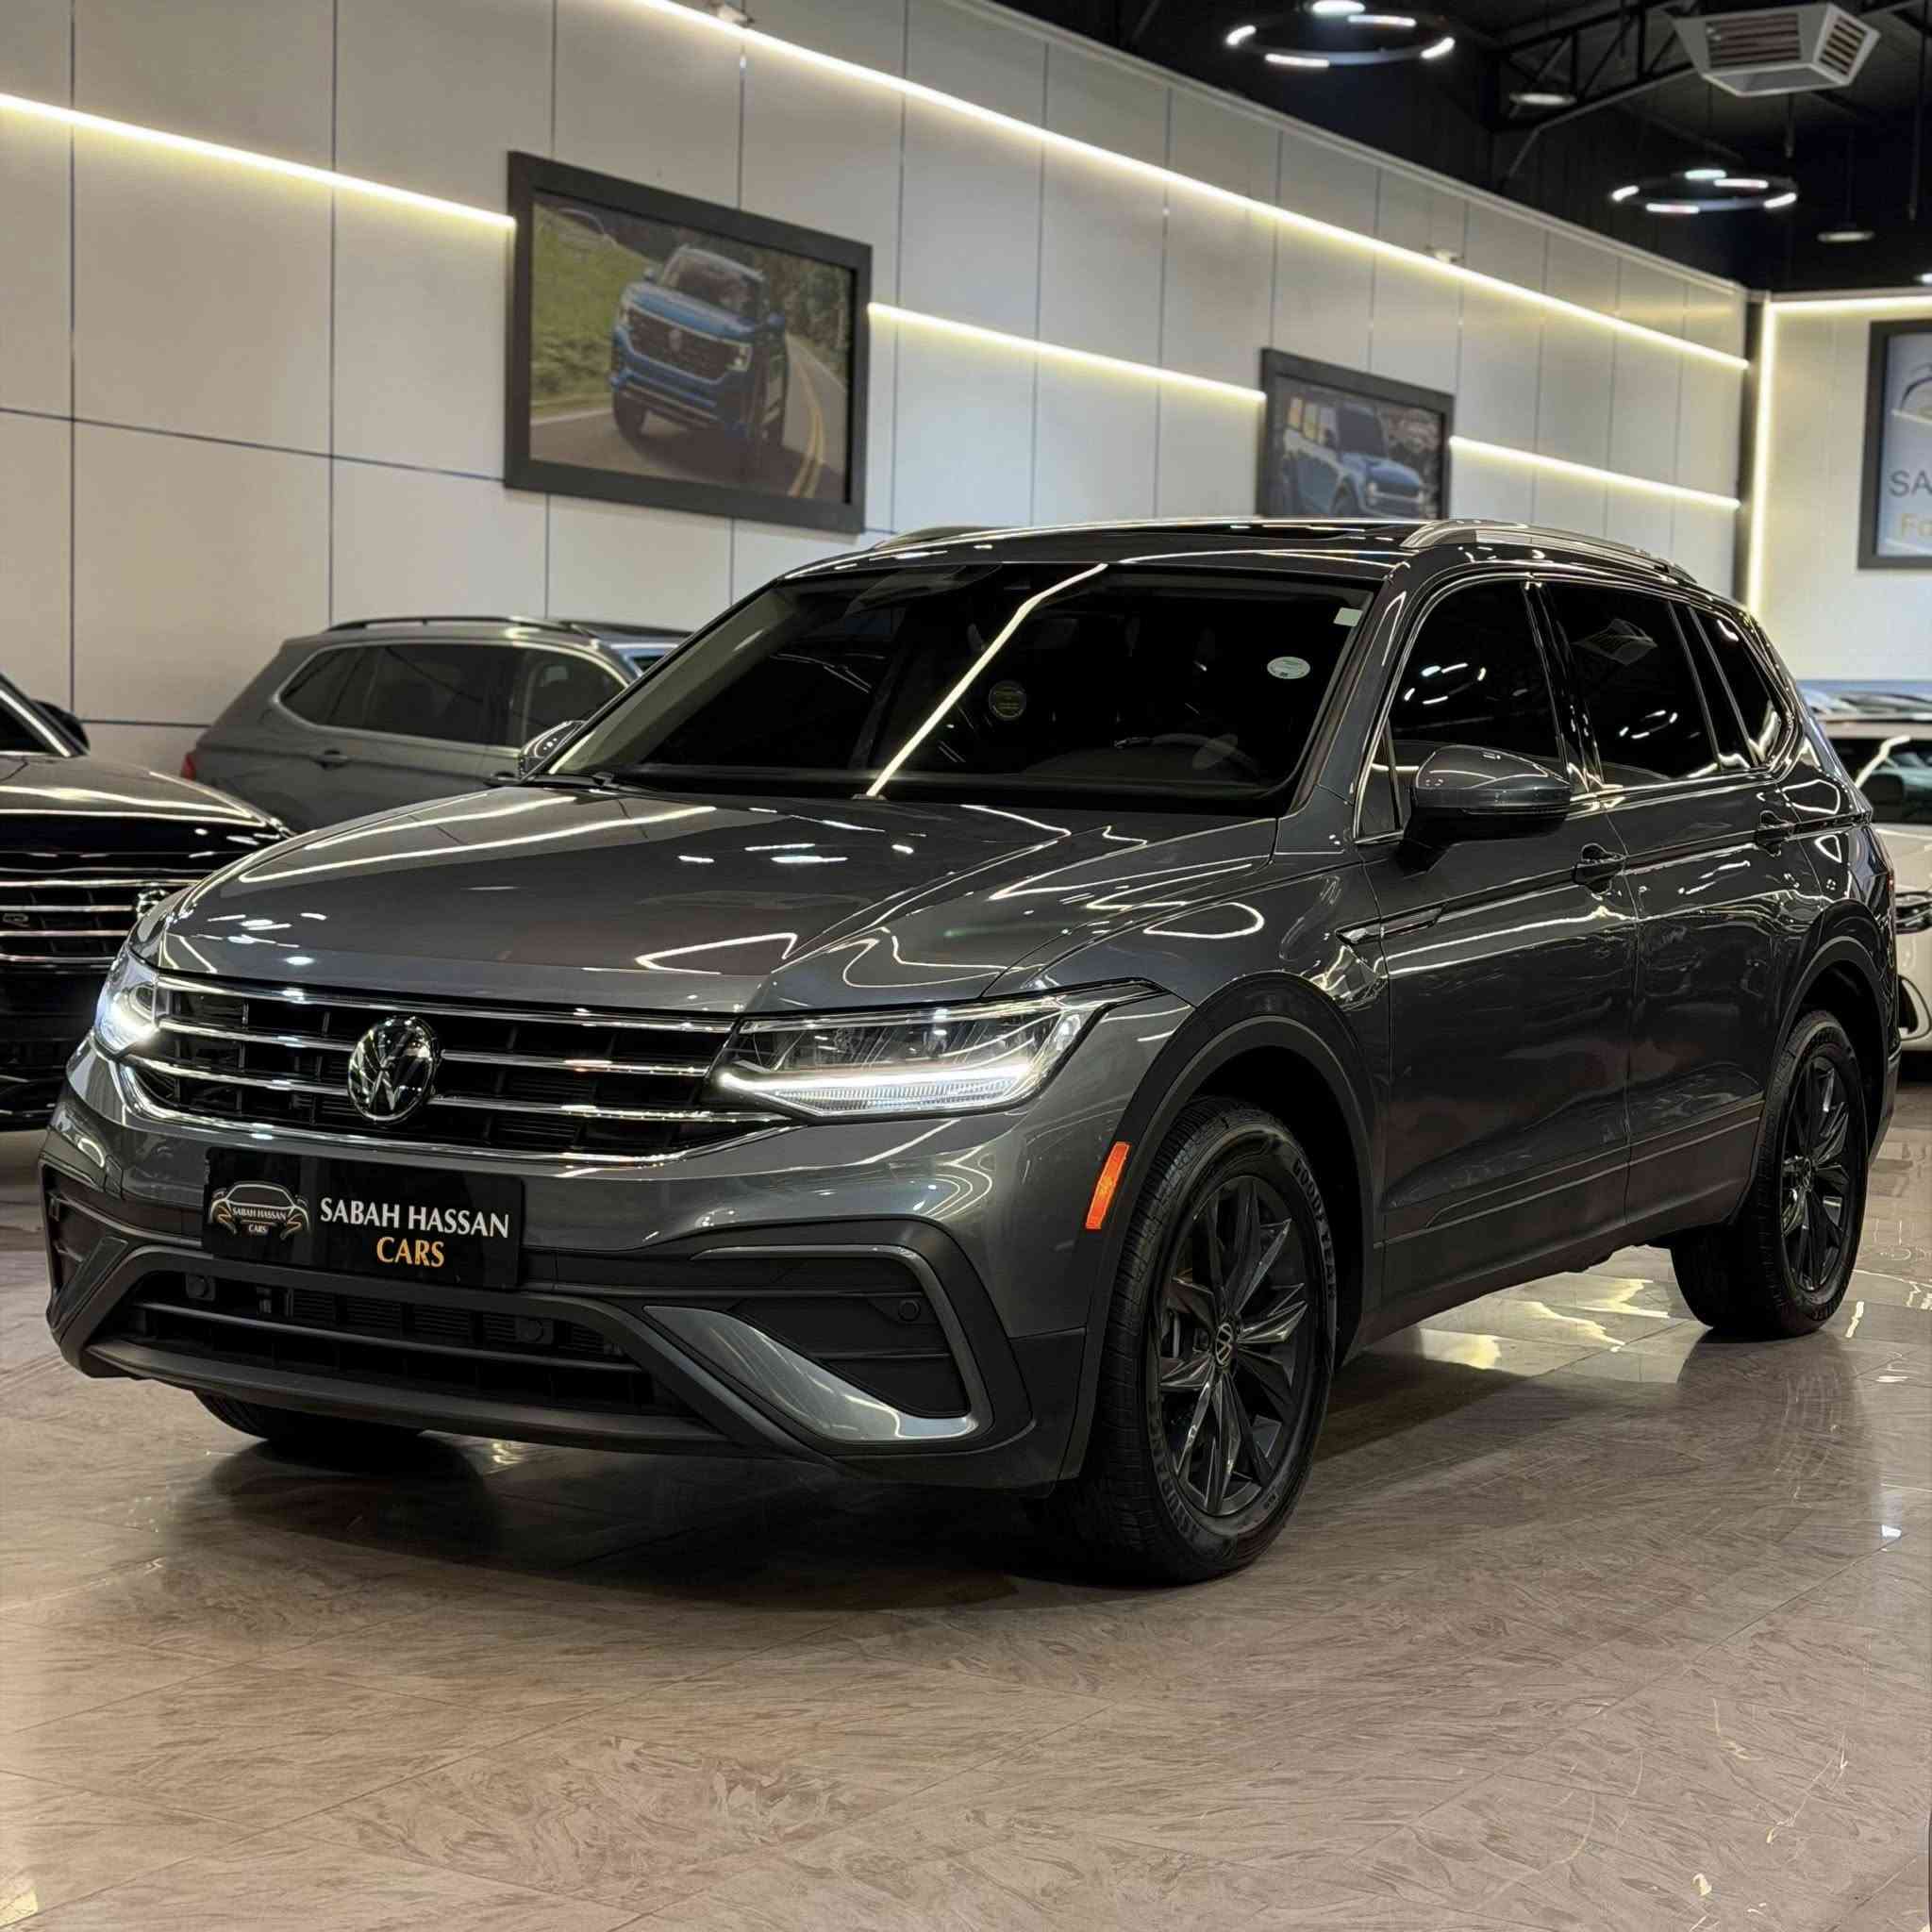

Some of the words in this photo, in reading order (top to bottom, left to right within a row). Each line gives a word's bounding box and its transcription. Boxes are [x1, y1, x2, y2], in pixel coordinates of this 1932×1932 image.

[321, 1197, 401, 1228] SABAH
[408, 1205, 509, 1239] HASSAN
[376, 1237, 445, 1268] CARS
